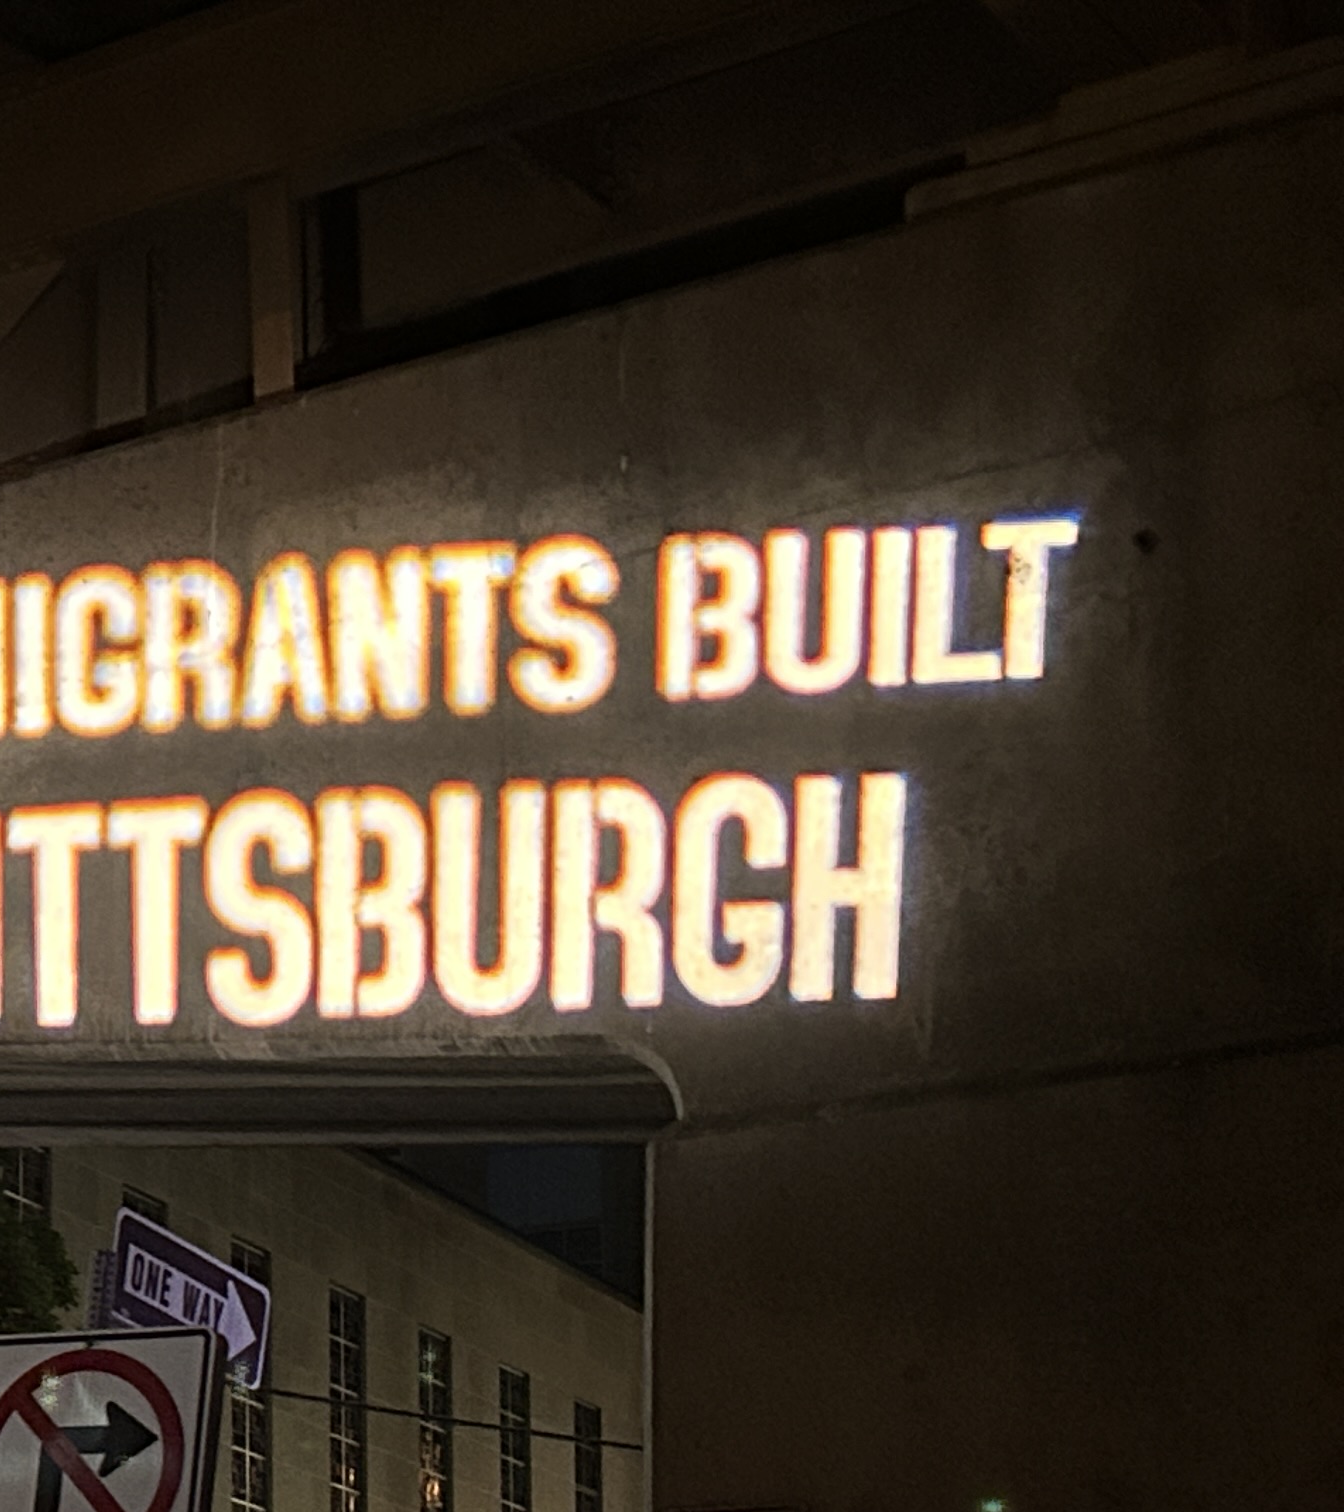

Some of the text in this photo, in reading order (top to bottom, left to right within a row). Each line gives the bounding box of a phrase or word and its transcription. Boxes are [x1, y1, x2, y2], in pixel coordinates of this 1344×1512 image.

[656, 514, 1080, 704] BUILT
[131, 1253, 225, 1333] ONE WAY
